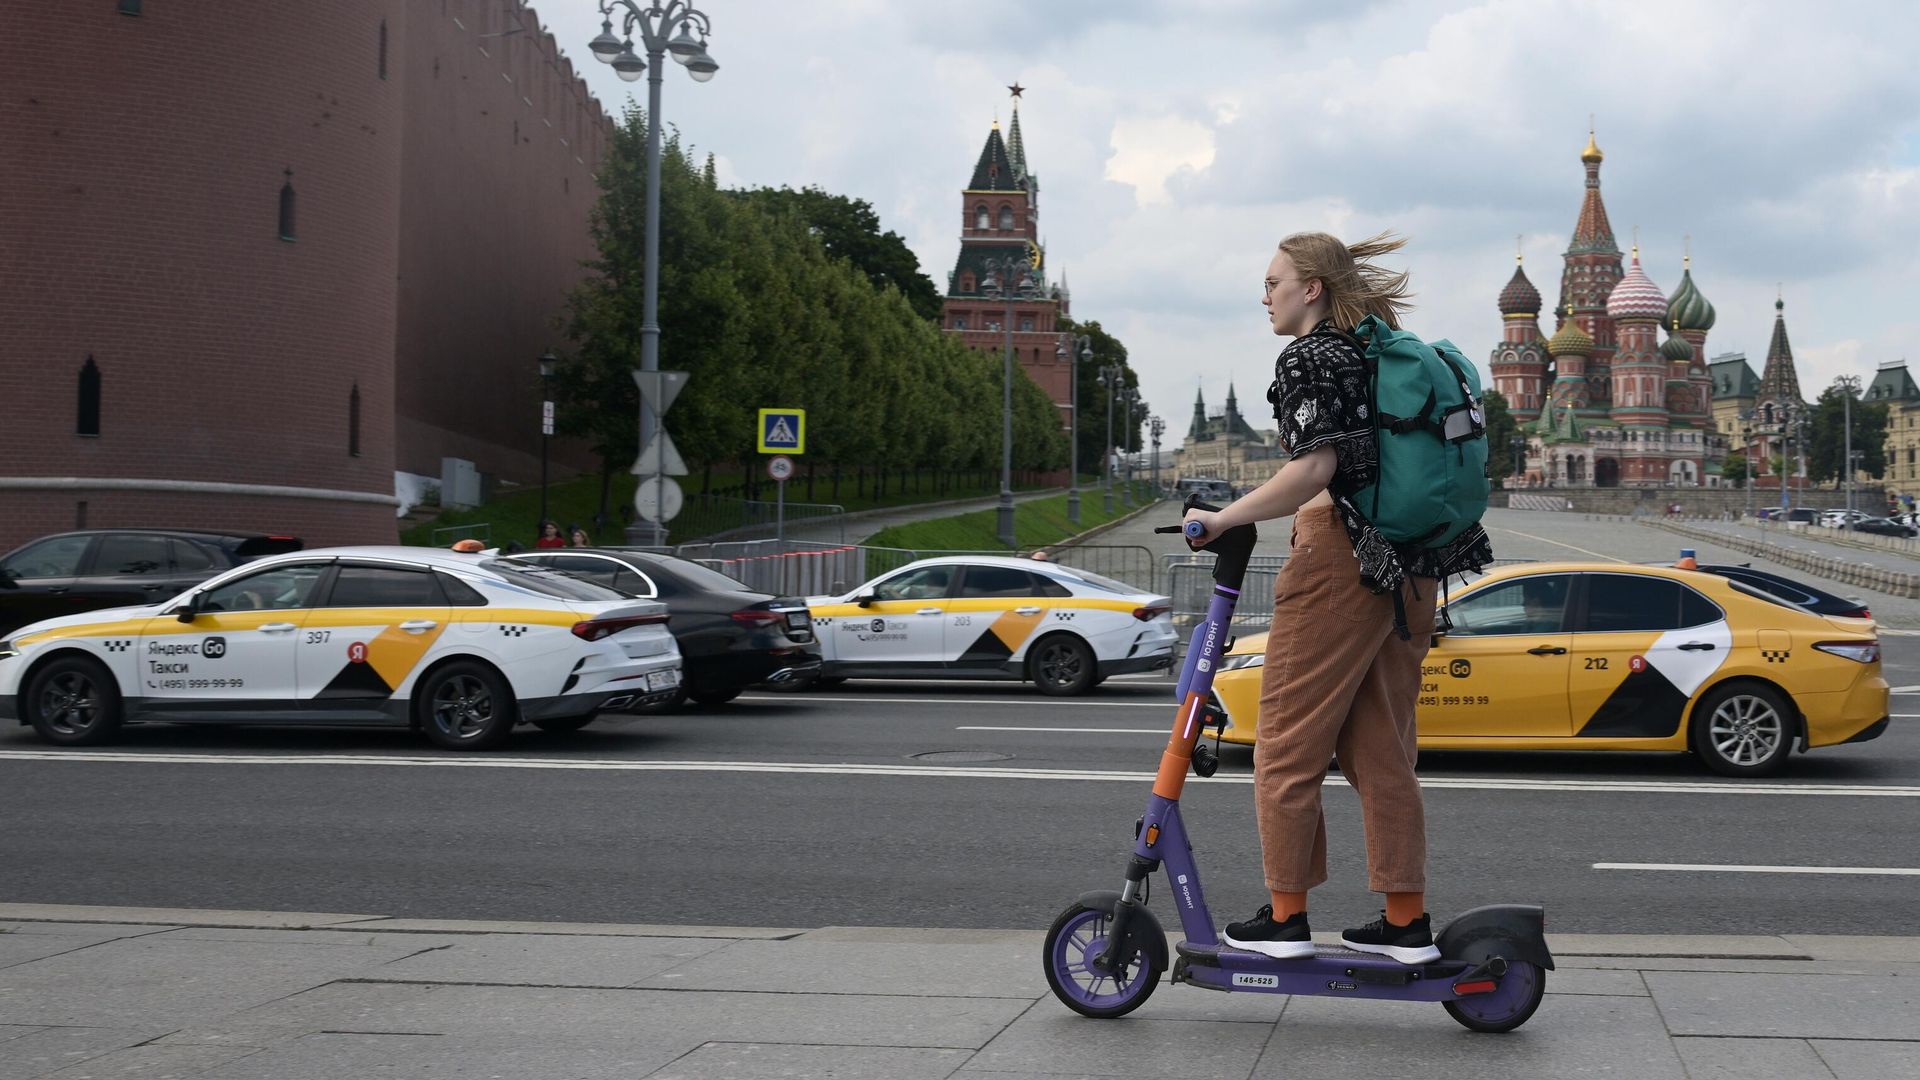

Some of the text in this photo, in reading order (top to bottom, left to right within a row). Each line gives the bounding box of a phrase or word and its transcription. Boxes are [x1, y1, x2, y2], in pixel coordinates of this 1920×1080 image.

[954, 616, 971, 627] 203
[306, 631, 331, 644] 397
[1203, 620, 1219, 657] юрент
[148, 639, 225, 656] Яндекс Go
[351, 646, 364, 660] Я
[148, 660, 189, 674] Такси
[1420, 661, 1470, 676] декс Go
[1584, 657, 1608, 670] 212
[1631, 658, 1641, 669] Я
[160, 678, 244, 690] (495) 999-99-99
[1442, 696, 1460, 705] 999
[1463, 696, 1474, 705] 99
[1477, 695, 1489, 705] 99
